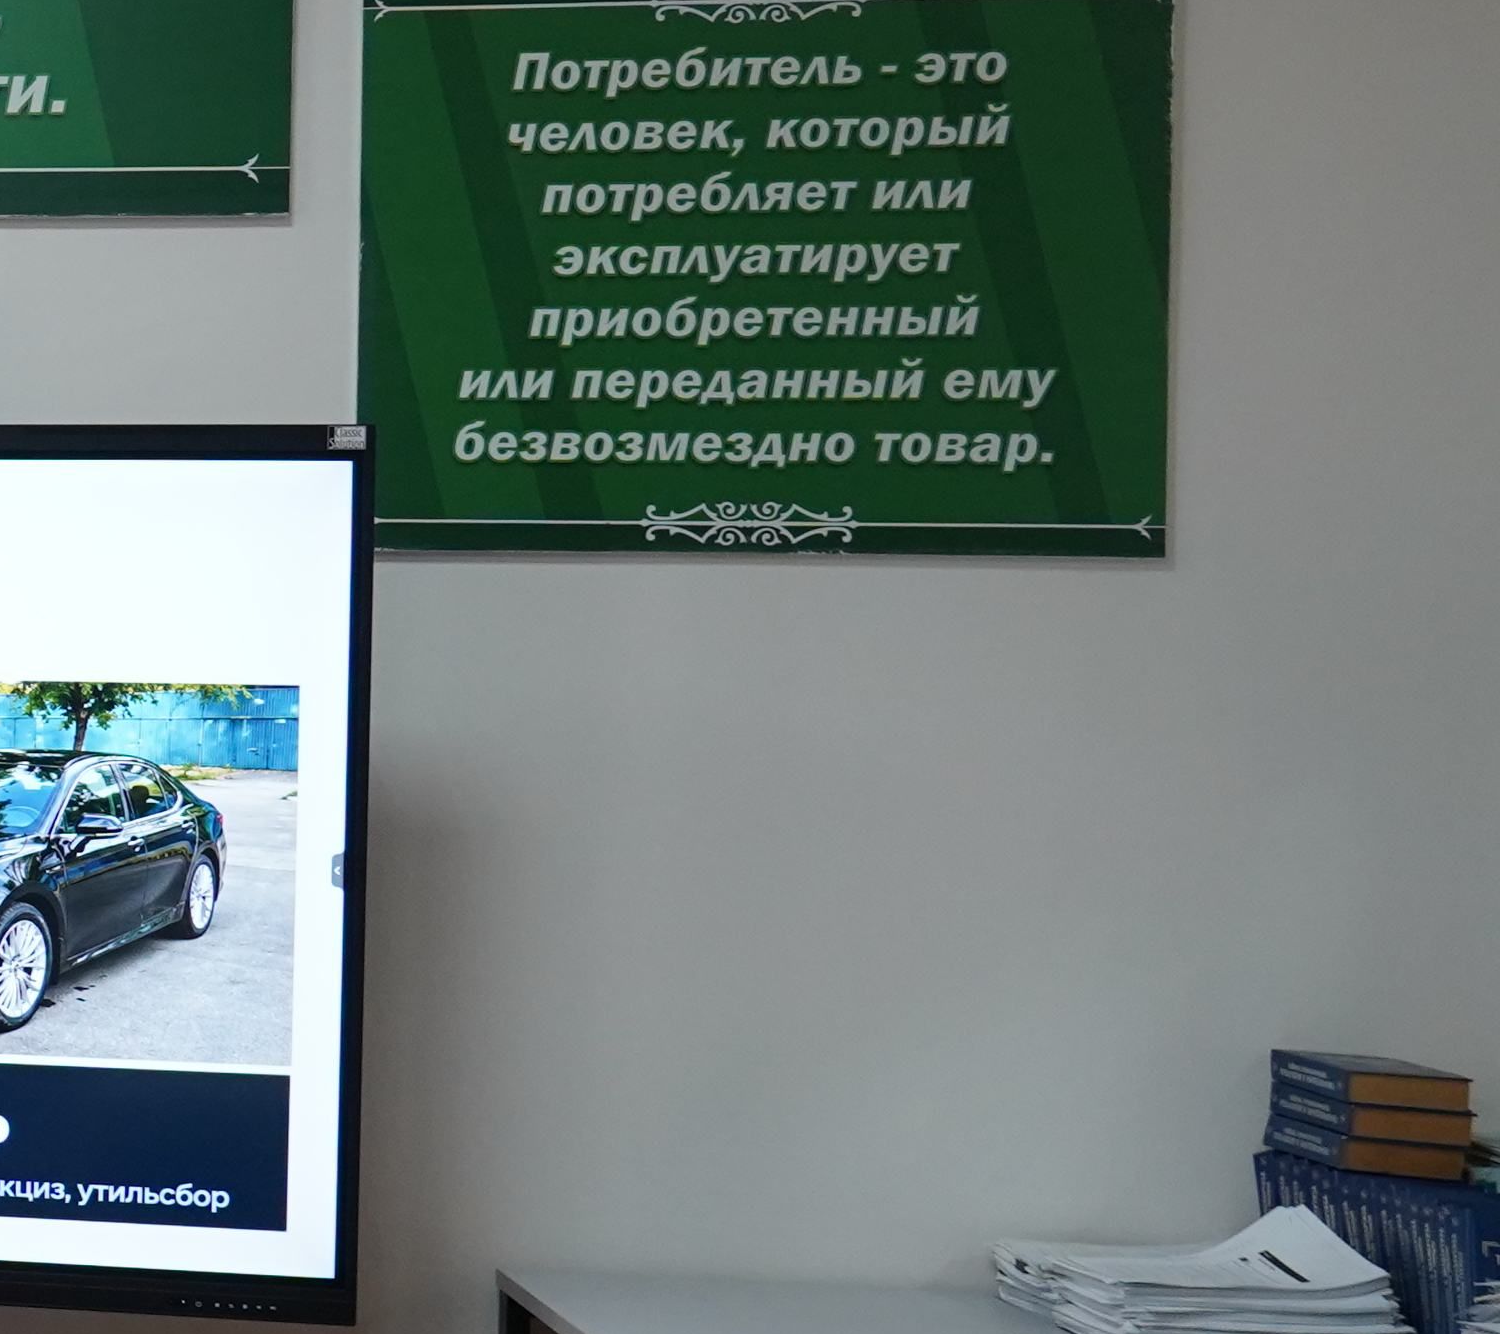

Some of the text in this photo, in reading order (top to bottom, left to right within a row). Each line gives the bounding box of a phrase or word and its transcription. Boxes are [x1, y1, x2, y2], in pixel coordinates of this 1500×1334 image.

[512, 46, 862, 98] Потребитель
[914, 51, 1008, 84] это
[508, 103, 1011, 157] человек, который
[541, 171, 972, 222] потребляет или
[553, 242, 961, 283] эксплуатирует
[529, 294, 980, 346] приобретенный
[458, 357, 1056, 409] или переданный ему
[454, 420, 1054, 472] безвозмездно товар.
[76, 1182, 230, 1214] утильсбор
